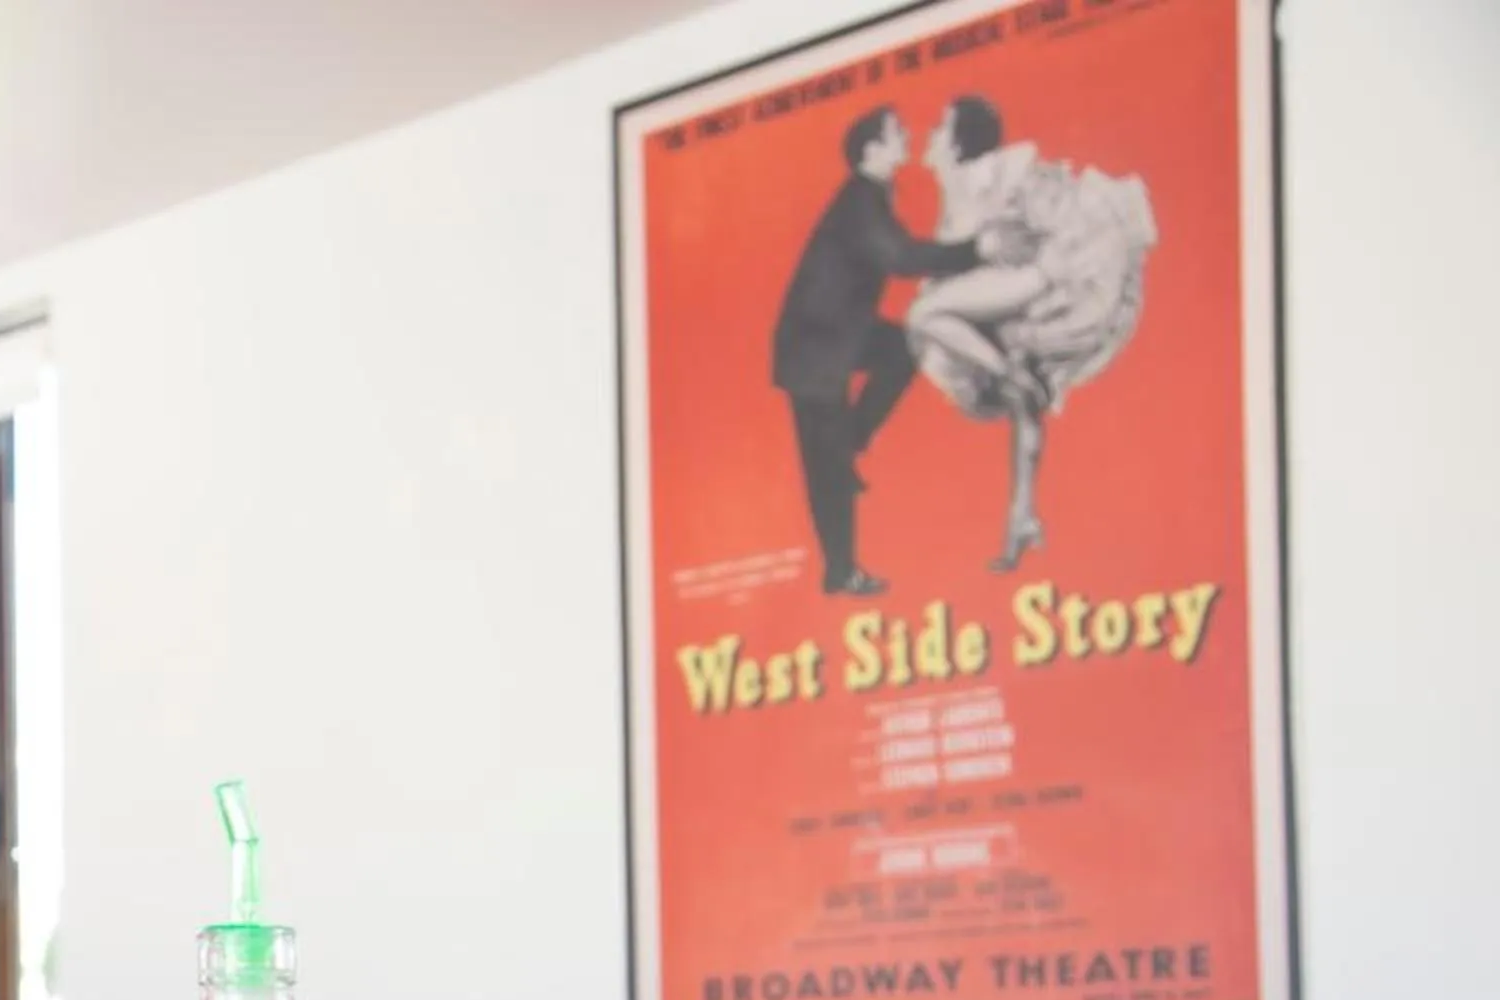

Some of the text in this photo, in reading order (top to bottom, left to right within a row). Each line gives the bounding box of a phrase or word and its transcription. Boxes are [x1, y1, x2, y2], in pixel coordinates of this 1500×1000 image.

[676, 580, 1219, 715] West Side Story
[991, 944, 1212, 990] THEATRE
